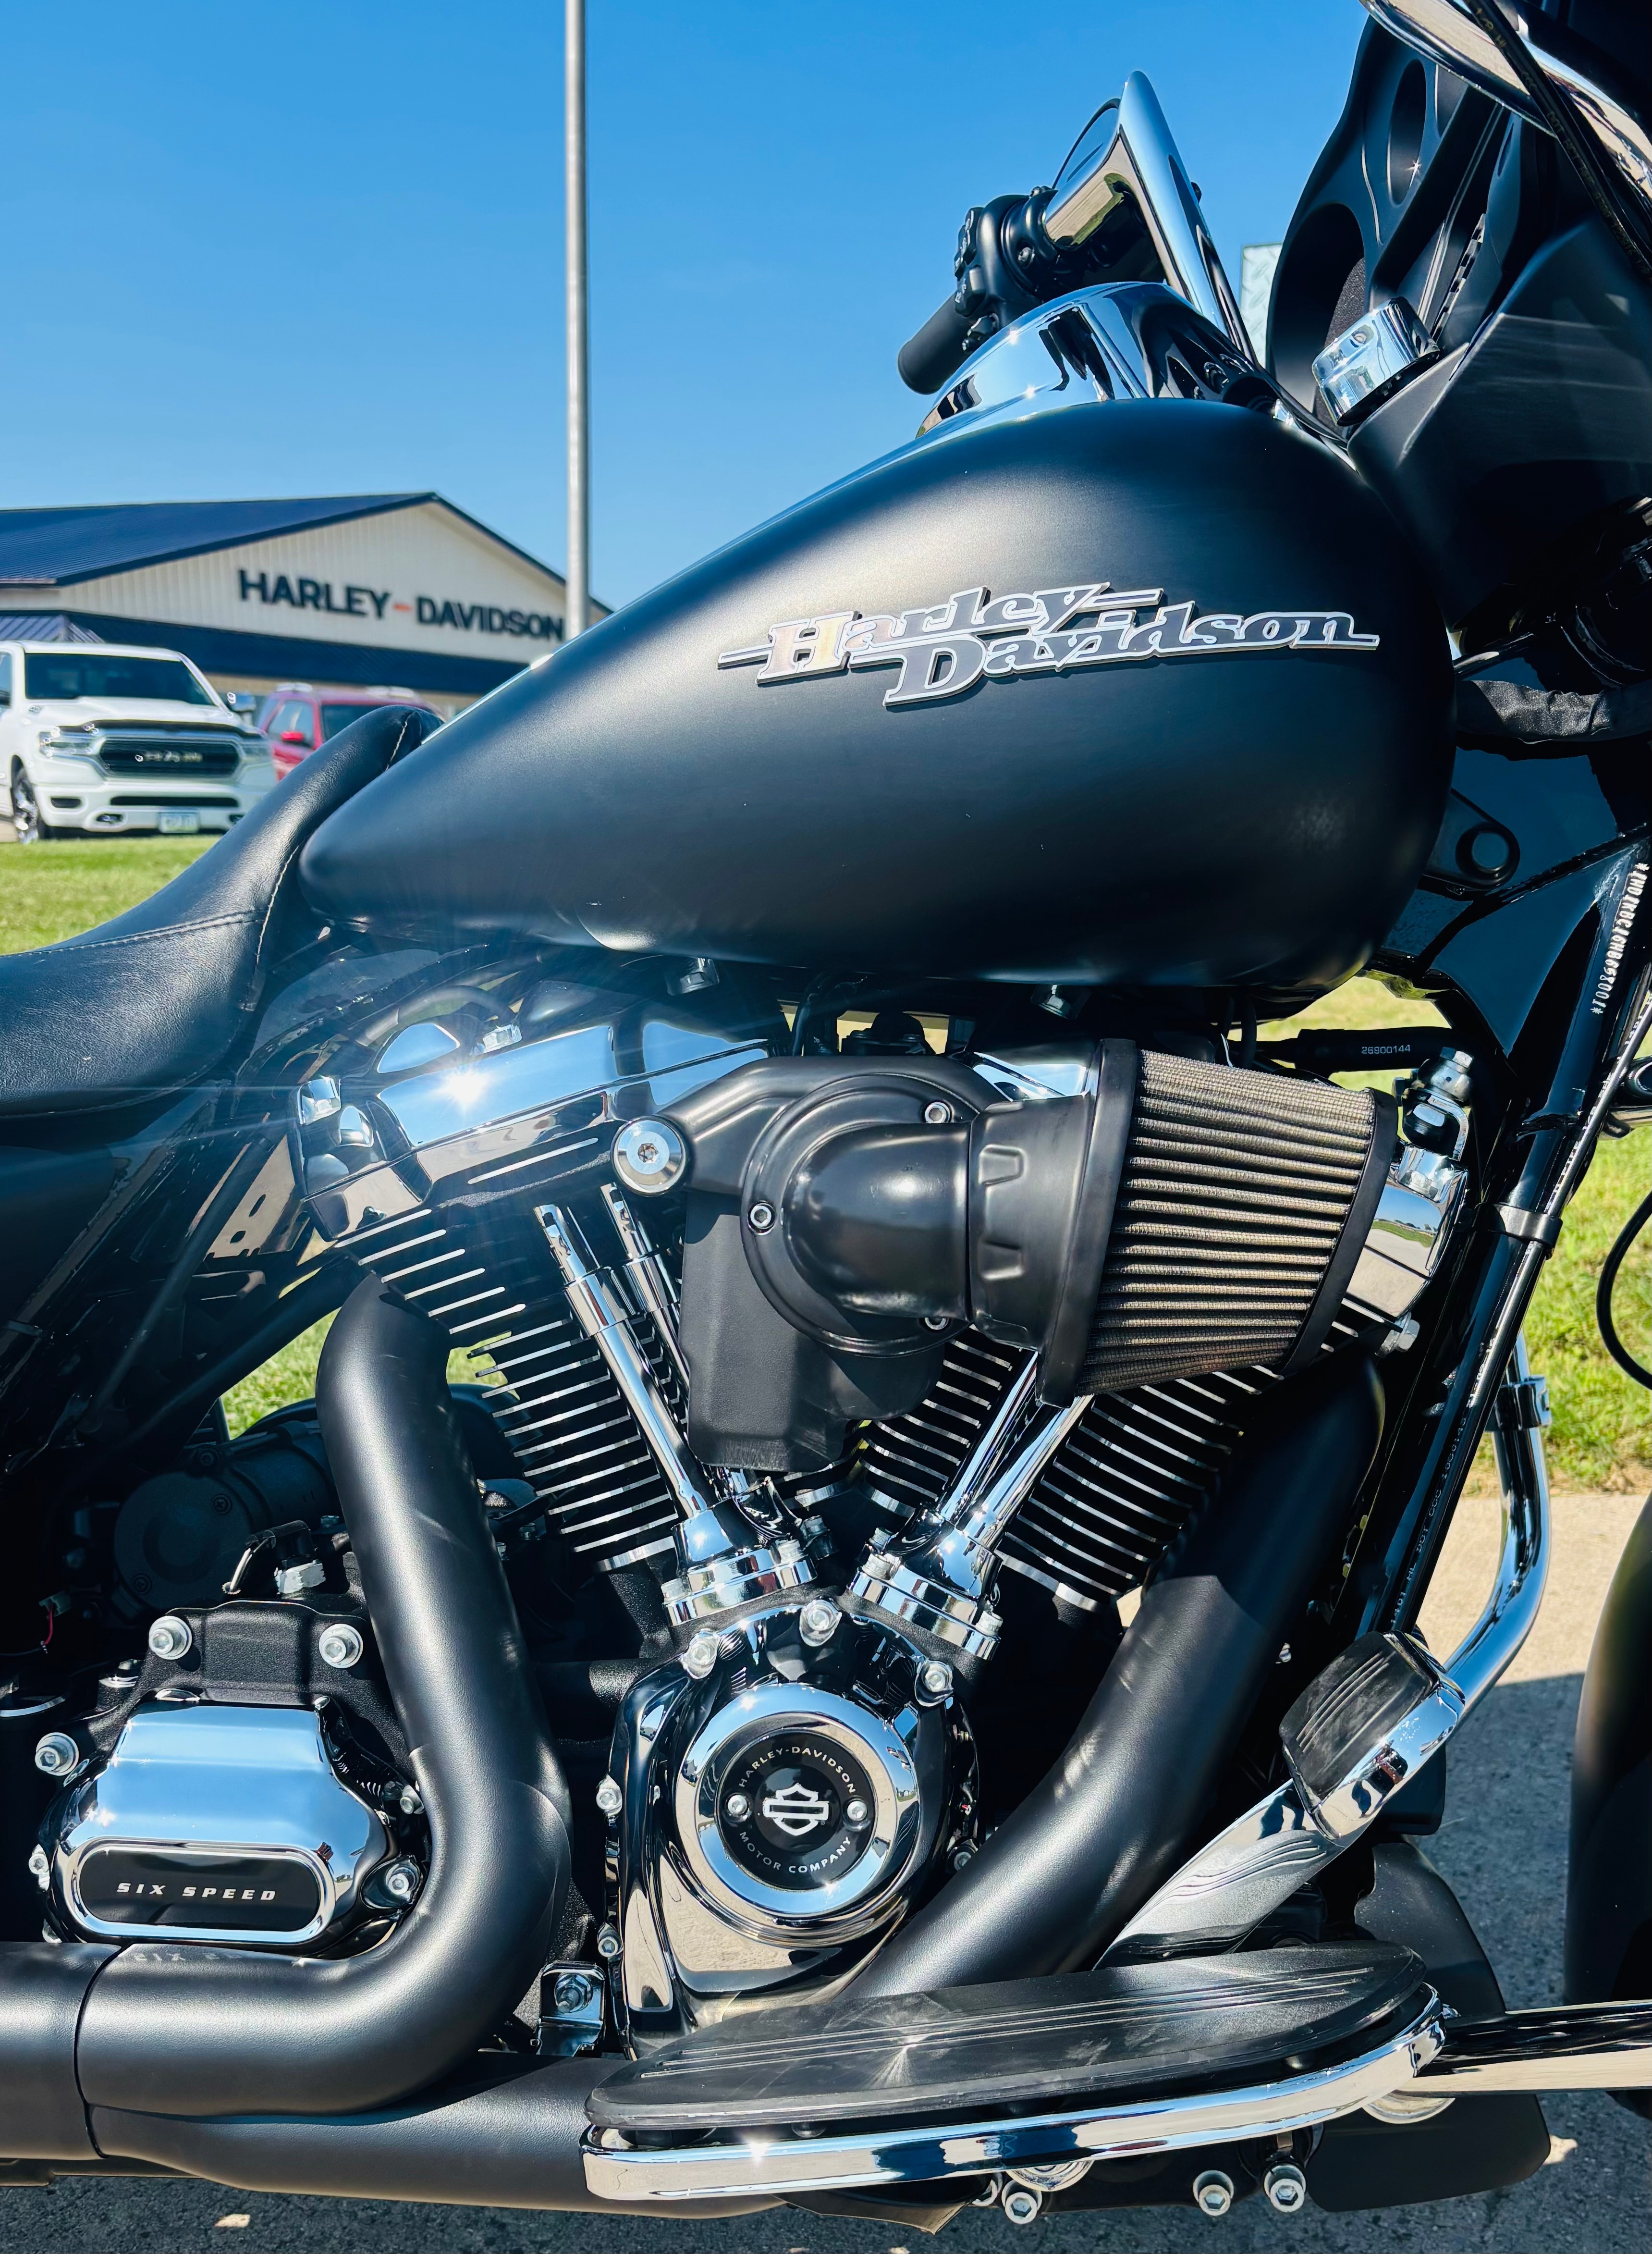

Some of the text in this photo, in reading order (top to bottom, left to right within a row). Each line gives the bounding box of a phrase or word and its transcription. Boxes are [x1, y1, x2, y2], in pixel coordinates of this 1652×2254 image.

[849, 601, 1380, 706] Davidson
[1361, 1044, 1411, 1055] 26900144
[739, 1746, 856, 1794] HARLEY-DAVIDSON
[739, 1831, 851, 1874] MOTOR COMPANY
[117, 1882, 276, 1901] SIX SPEED
